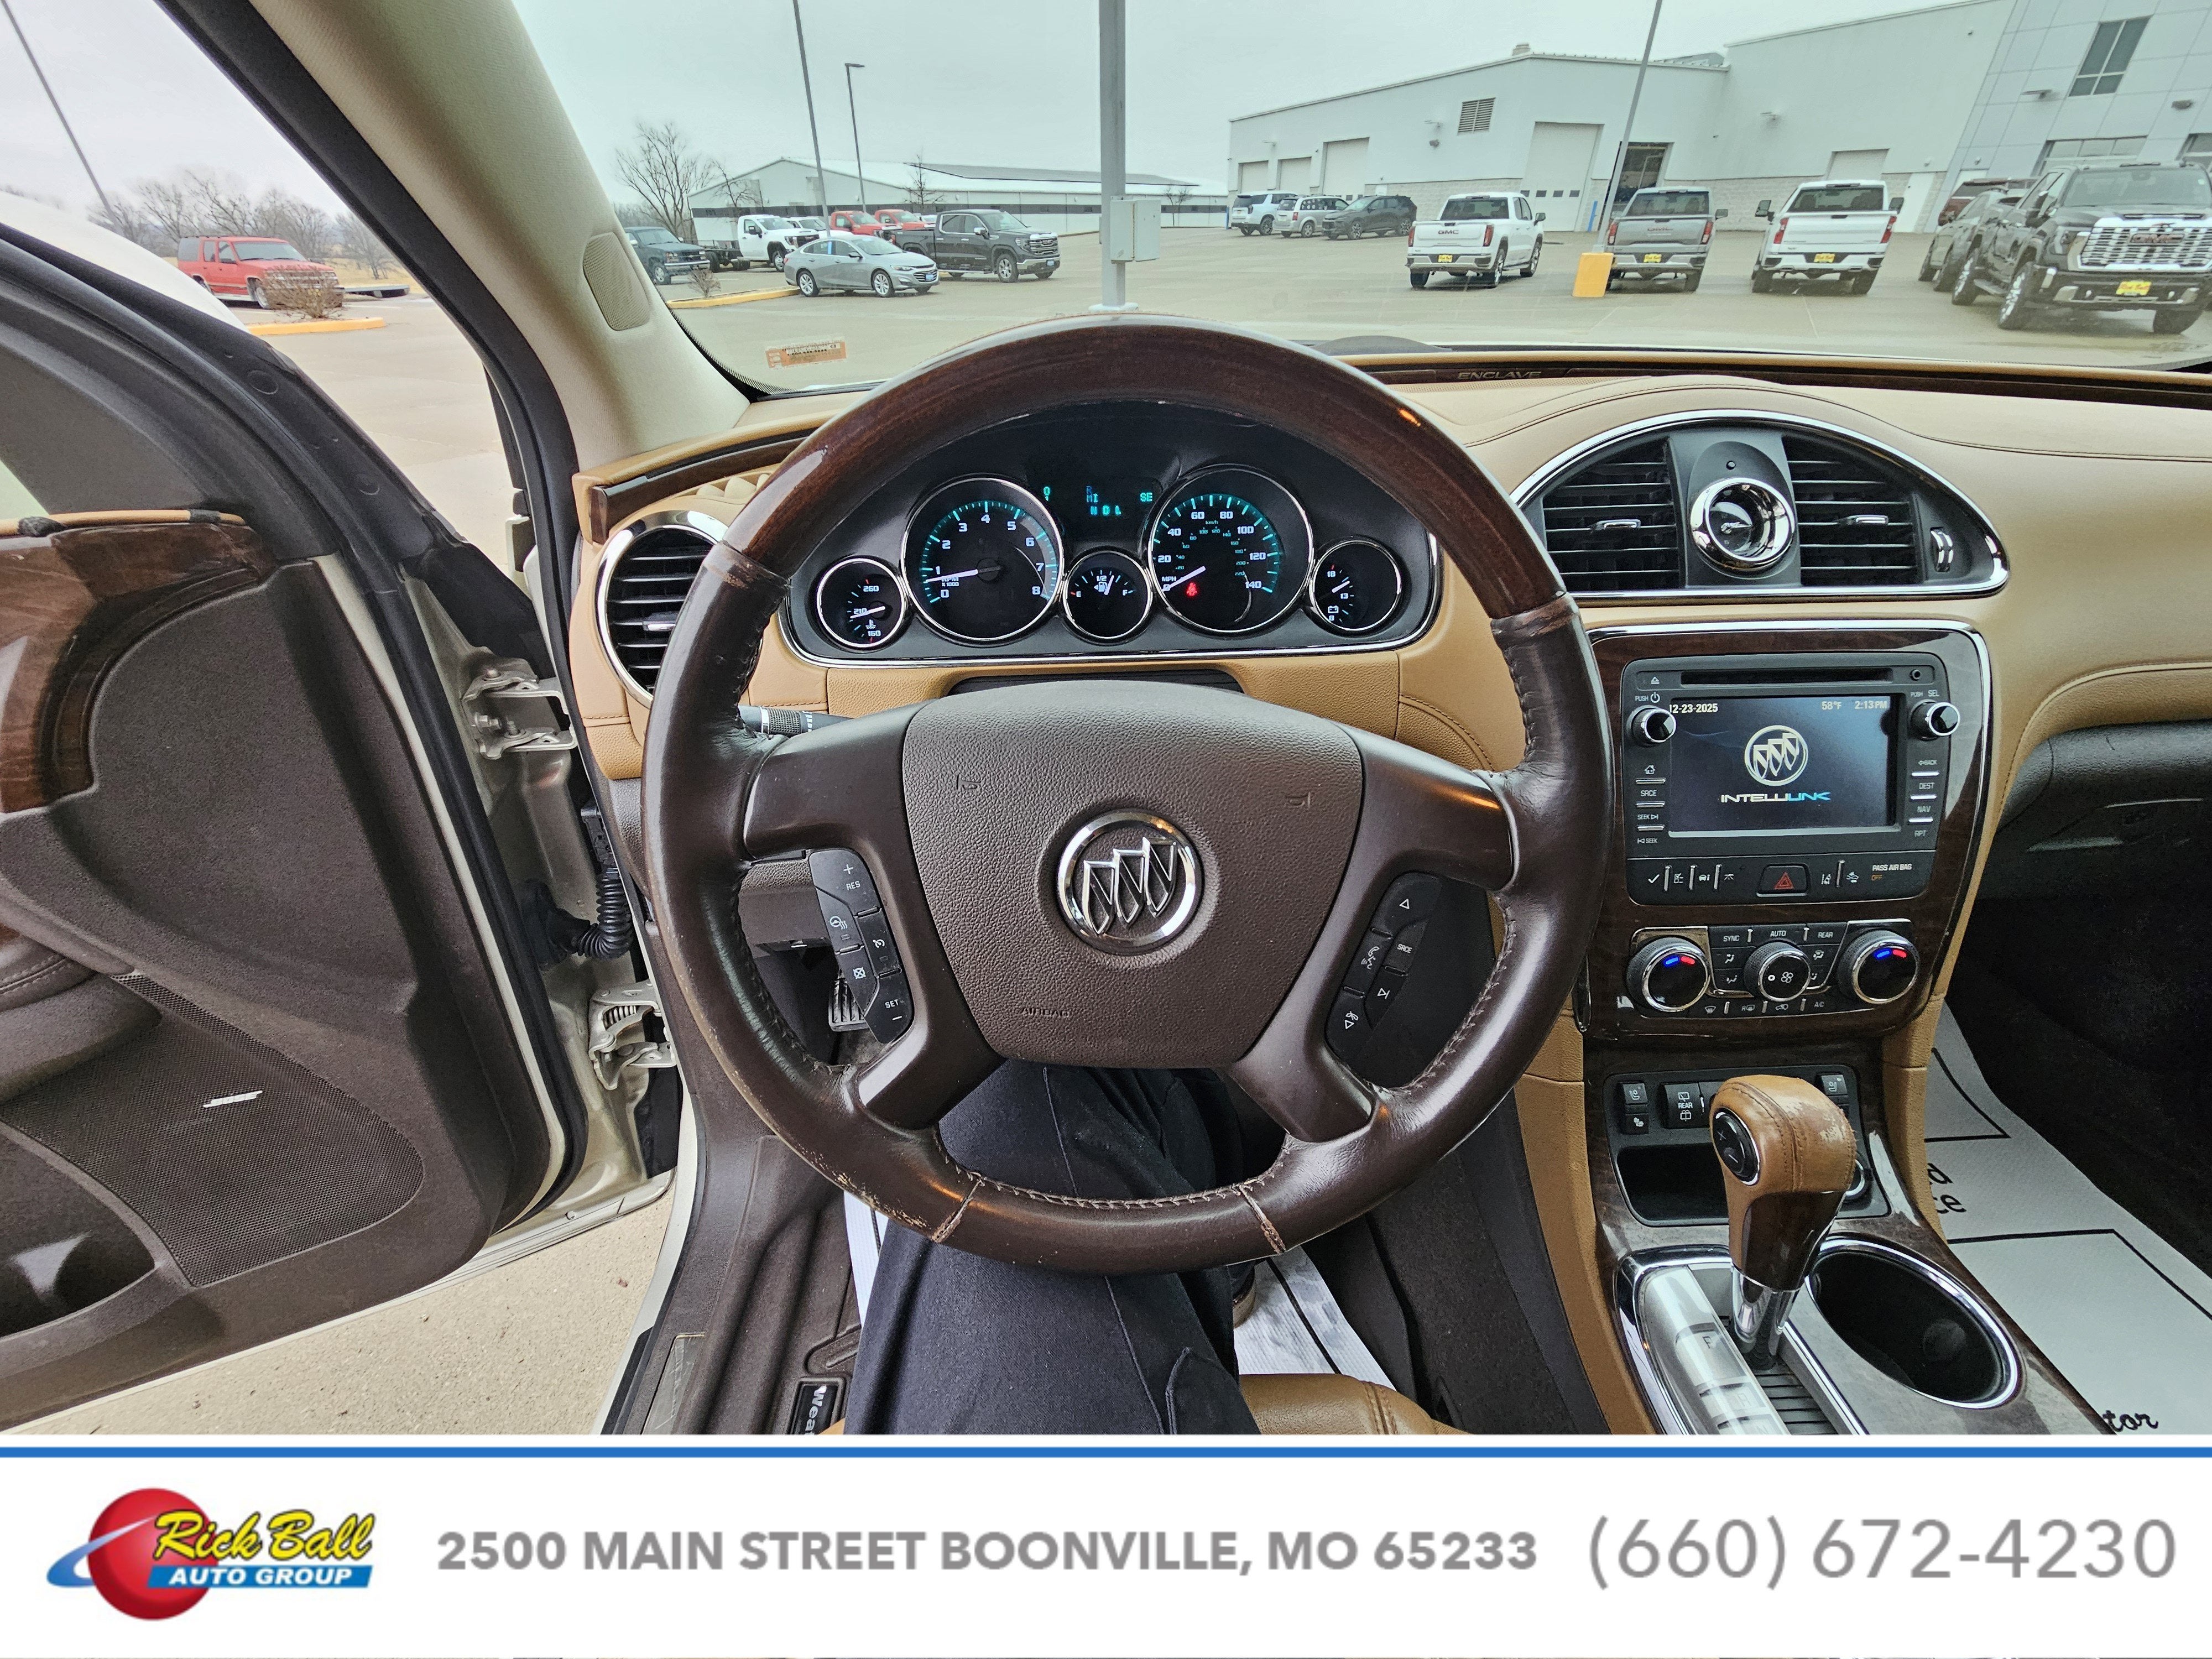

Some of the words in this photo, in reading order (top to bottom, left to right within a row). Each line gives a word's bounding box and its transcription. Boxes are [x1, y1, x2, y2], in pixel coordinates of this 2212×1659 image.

[2131, 233, 2184, 243] GMC
[1458, 371, 1542, 379] ENCLAVE
[1140, 492, 1153, 502] SE
[981, 514, 990, 523] 4
[1191, 511, 1205, 519] 60
[1219, 511, 1233, 519] 80
[958, 523, 967, 532] 3
[1007, 521, 1016, 530] 5
[1237, 526, 1254, 534] 100
[1167, 528, 1182, 536] 40
[942, 540, 951, 549] 2
[1025, 537, 1035, 546] 6
[1157, 555, 1172, 563] 20
[1249, 552, 1266, 560] 120
[935, 566, 940, 575] 1
[1035, 562, 1044, 572] 7
[940, 589, 950, 598] 0
[1032, 586, 1041, 595] 8
[1928, 689, 1940, 697] SEL
[1669, 703, 1719, 713] 12-23-2025
[846, 880, 861, 890] RES
[1397, 943, 1413, 953] SRCE
[885, 998, 900, 1009] SET
